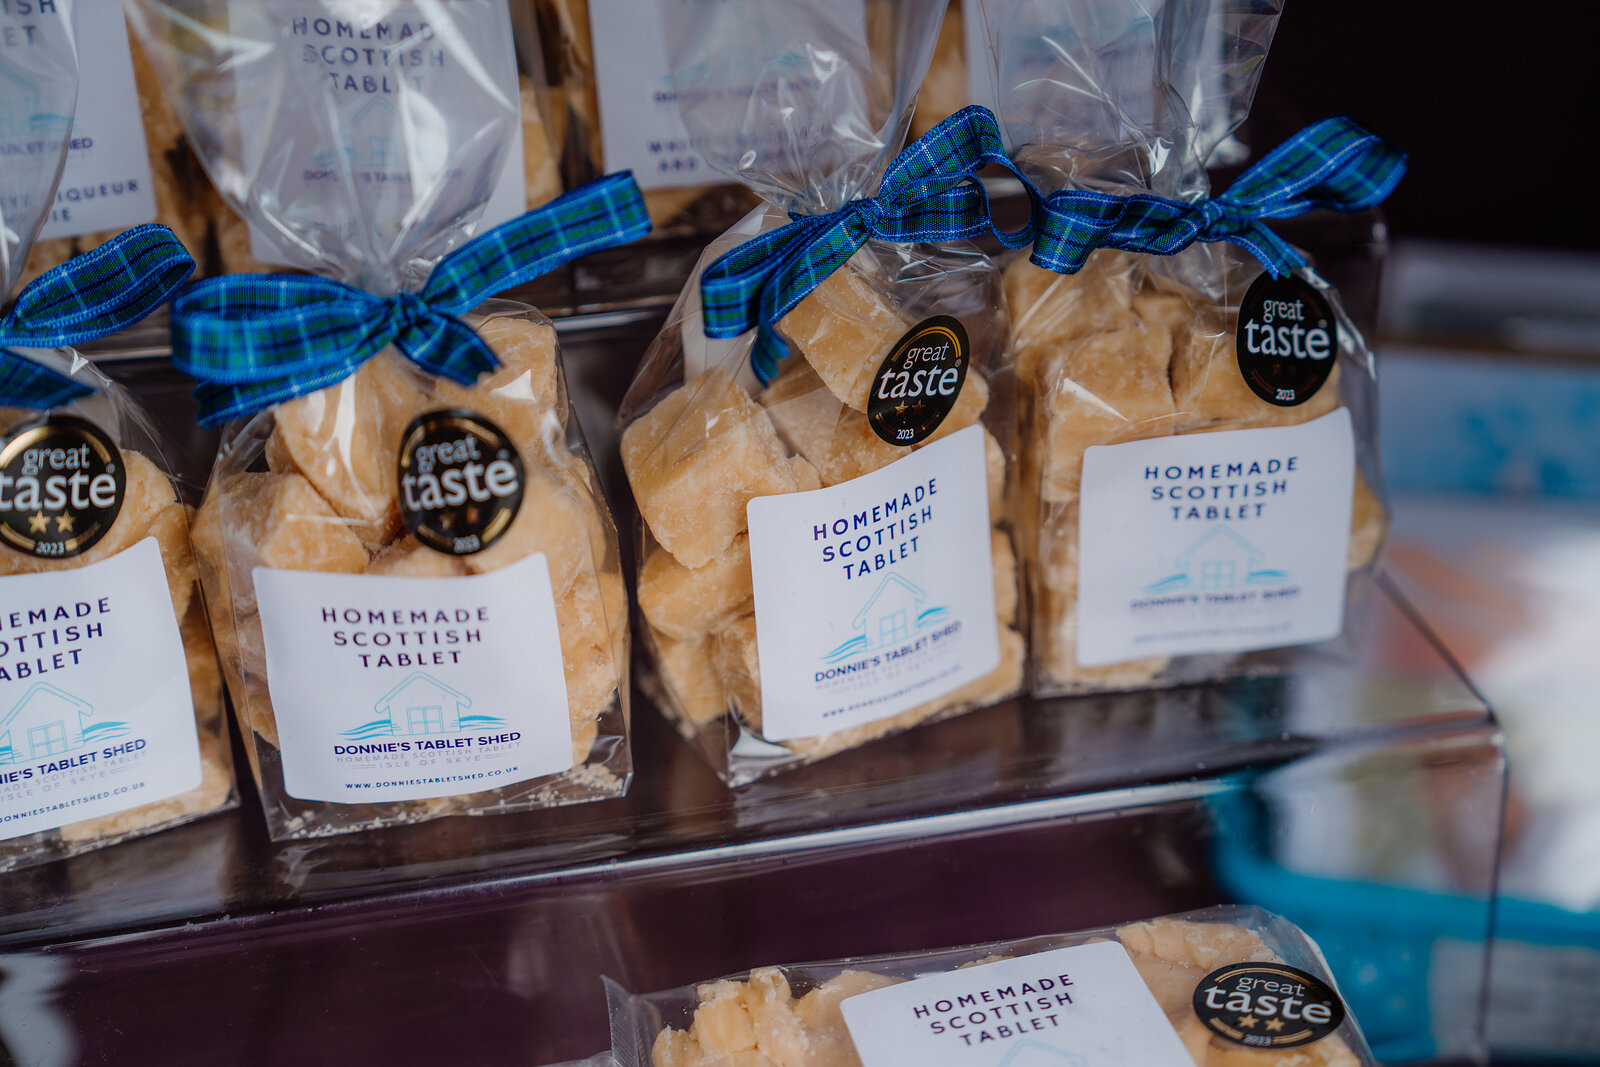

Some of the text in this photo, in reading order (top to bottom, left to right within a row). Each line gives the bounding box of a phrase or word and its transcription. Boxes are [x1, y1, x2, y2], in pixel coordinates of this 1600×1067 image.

[328, 72, 425, 94] TABLT
[1262, 299, 1305, 323] great
[1244, 317, 1331, 360] taste
[902, 341, 950, 370] great
[877, 364, 959, 400] taste
[1275, 388, 1296, 401] 2023
[896, 429, 915, 440] 2023
[21, 442, 91, 476] great
[415, 433, 481, 474] great
[1145, 456, 1298, 480] HOMEMADE
[401, 460, 519, 512] taste
[1151, 479, 1287, 501] SCOTTISH
[812, 477, 938, 541] HOMEMADE
[1171, 502, 1265, 520] TABLET
[822, 505, 932, 562] SCOTTISH
[36, 541, 65, 556] 2023
[843, 536, 919, 580] TABLET
[321, 606, 489, 625] HOMEMADE
[333, 628, 481, 647] SCOTTISH
[358, 650, 461, 668] TABLET
[815, 656, 881, 682] DONNIE'S
[884, 636, 928, 662] TABLET
[334, 731, 521, 755] DONNIE'S TABLET SHED
[336, 741, 521, 763] HOMEMADE SCOTTISH TABLET
[37, 751, 98, 775] TABLET
[102, 739, 147, 759] SHED
[379, 755, 481, 769] ISLE OF SKYE
[34, 764, 98, 786] SCOTTISH
[42, 781, 61, 792] OF
[70, 769, 106, 786] SKYE
[913, 973, 1074, 1019] HOMEMADE
[1235, 976, 1306, 997] great
[930, 992, 1073, 1034] SCOTTISH
[1204, 985, 1332, 1025] taste
[959, 1014, 1059, 1047] TABLET
[1243, 1033, 1272, 1046] 2023
